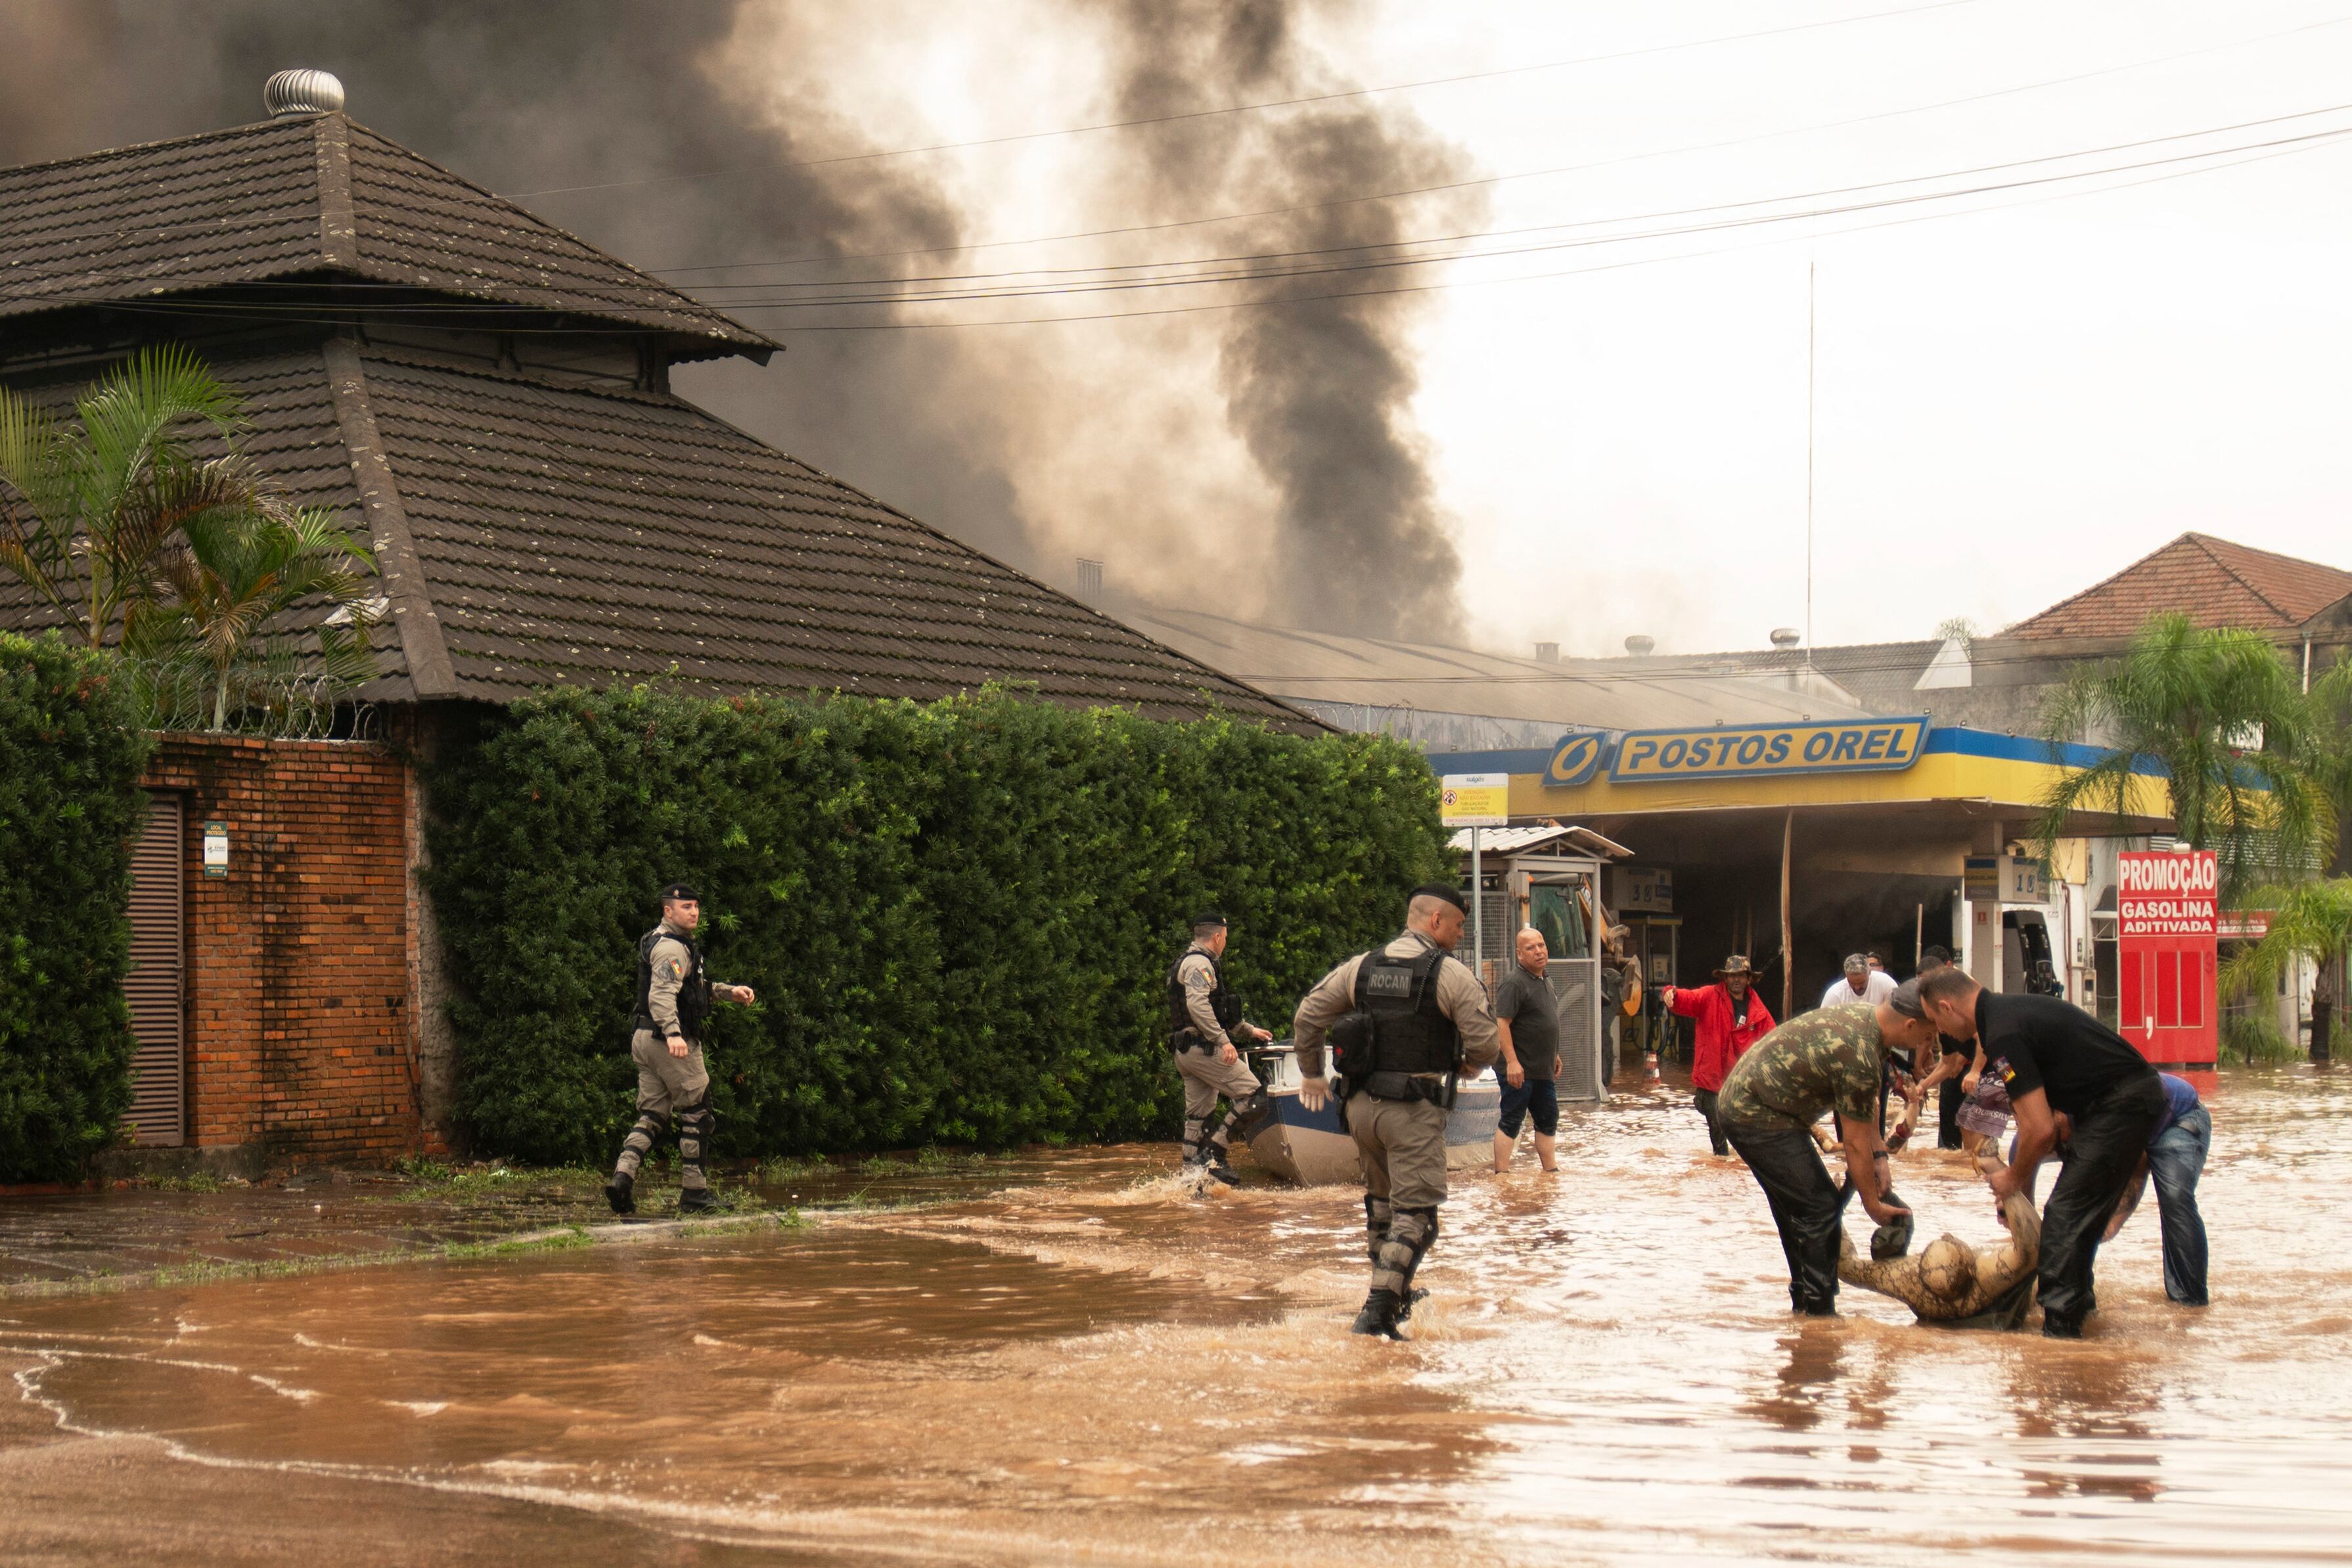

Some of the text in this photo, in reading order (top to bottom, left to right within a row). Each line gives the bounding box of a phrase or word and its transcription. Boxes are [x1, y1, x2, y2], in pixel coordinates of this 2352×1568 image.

[1629, 728, 1908, 769] POSTOS OREL
[2119, 853, 2215, 898] PROMOÇÃO
[2121, 901, 2214, 919] GASOLINA
[2123, 921, 2213, 933] ADITIVADA
[1370, 974, 1410, 989] ROCAM
